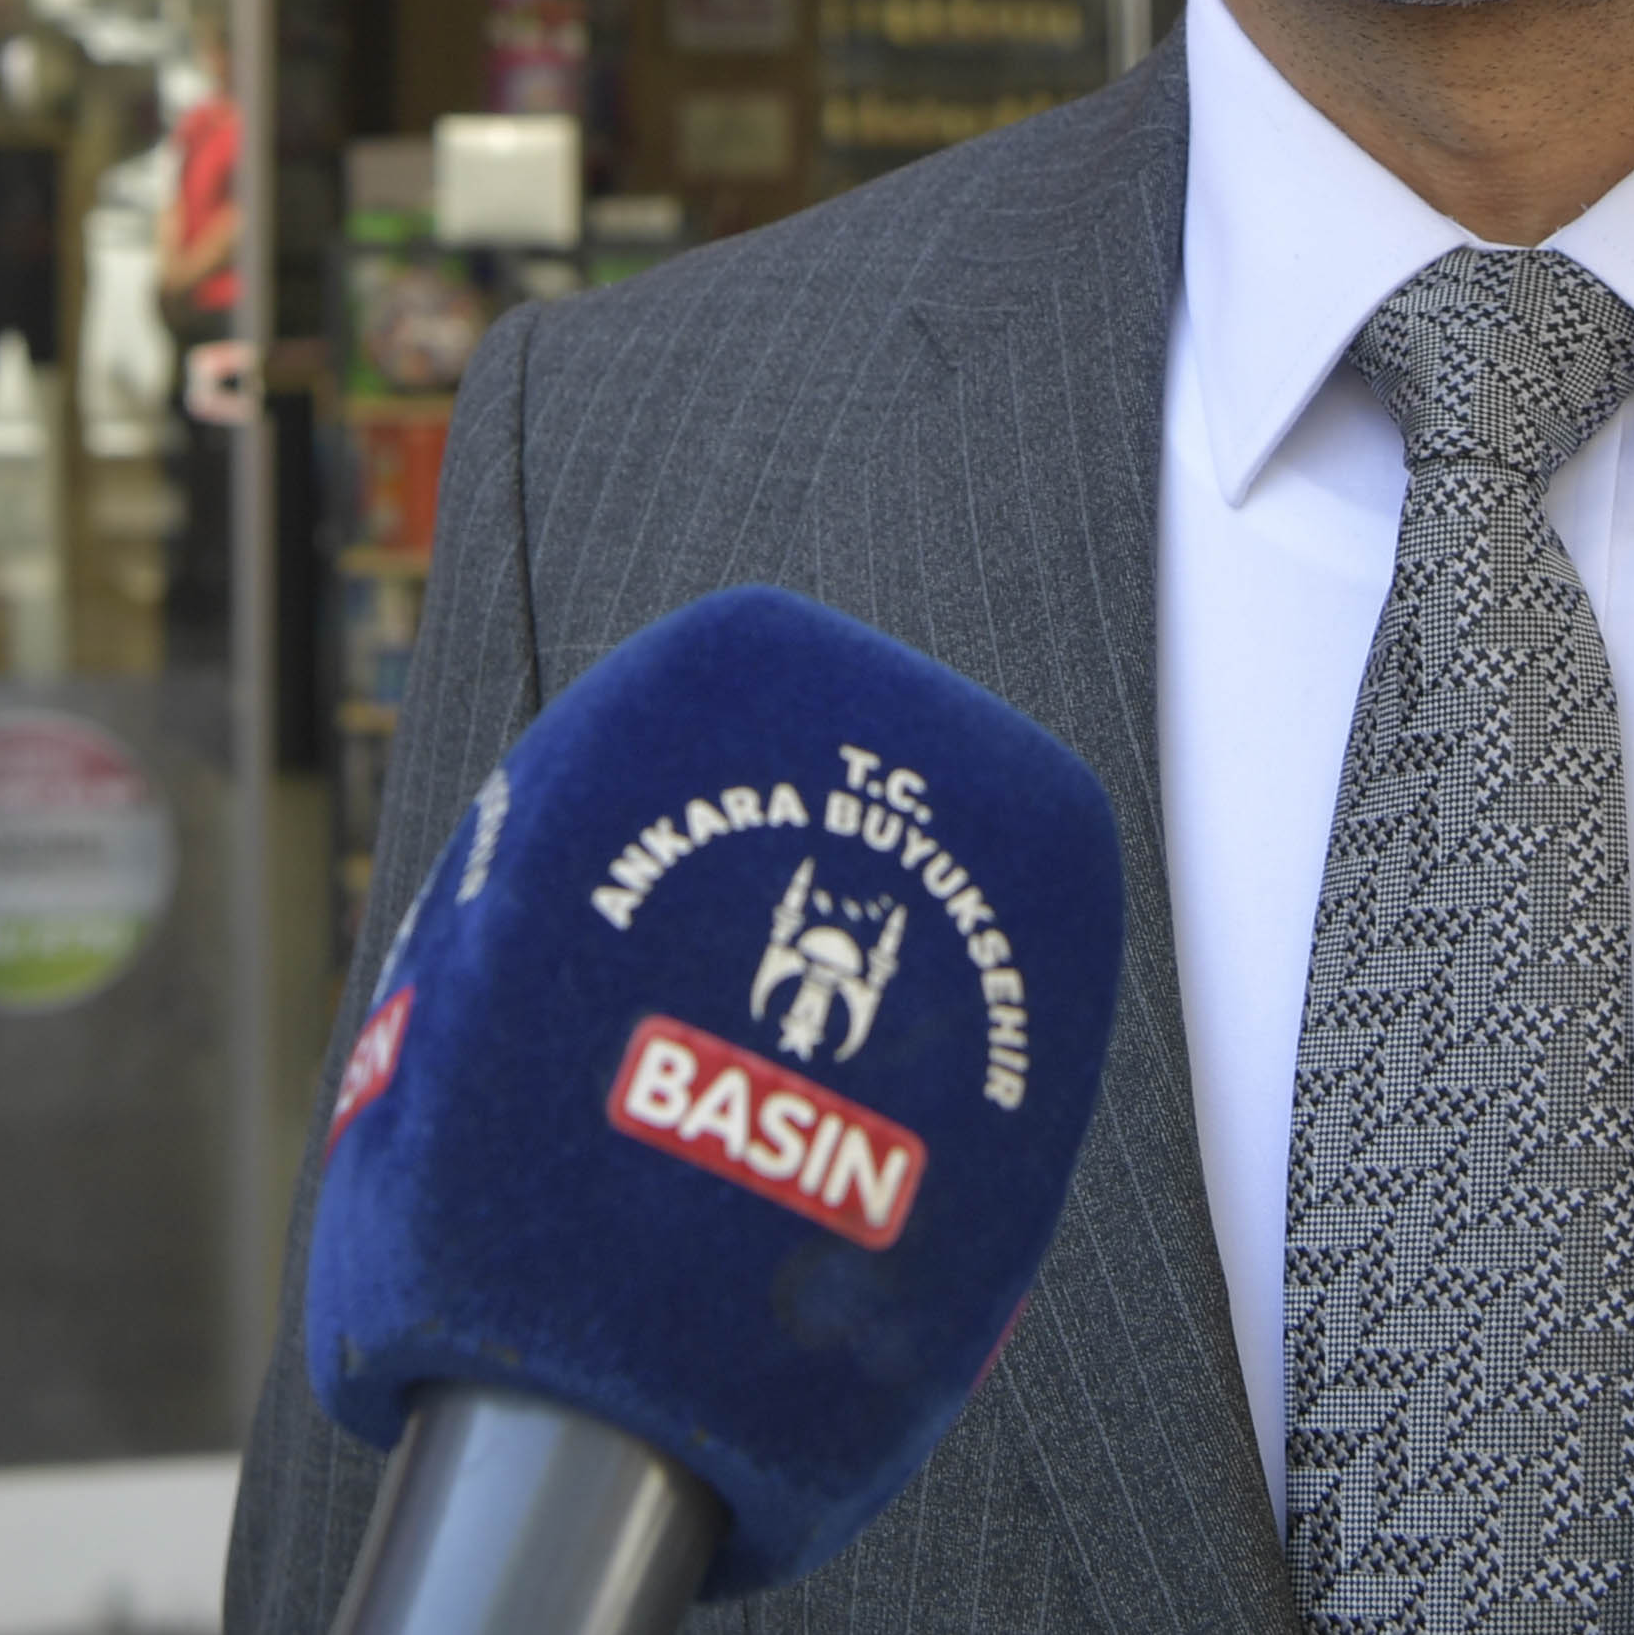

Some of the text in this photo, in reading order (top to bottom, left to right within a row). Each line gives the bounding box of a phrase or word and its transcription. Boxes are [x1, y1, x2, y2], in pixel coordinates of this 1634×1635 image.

[590, 782, 810, 931] ANKARA
[839, 743, 933, 825] T.C.
[623, 1036, 910, 1228] BASIN
